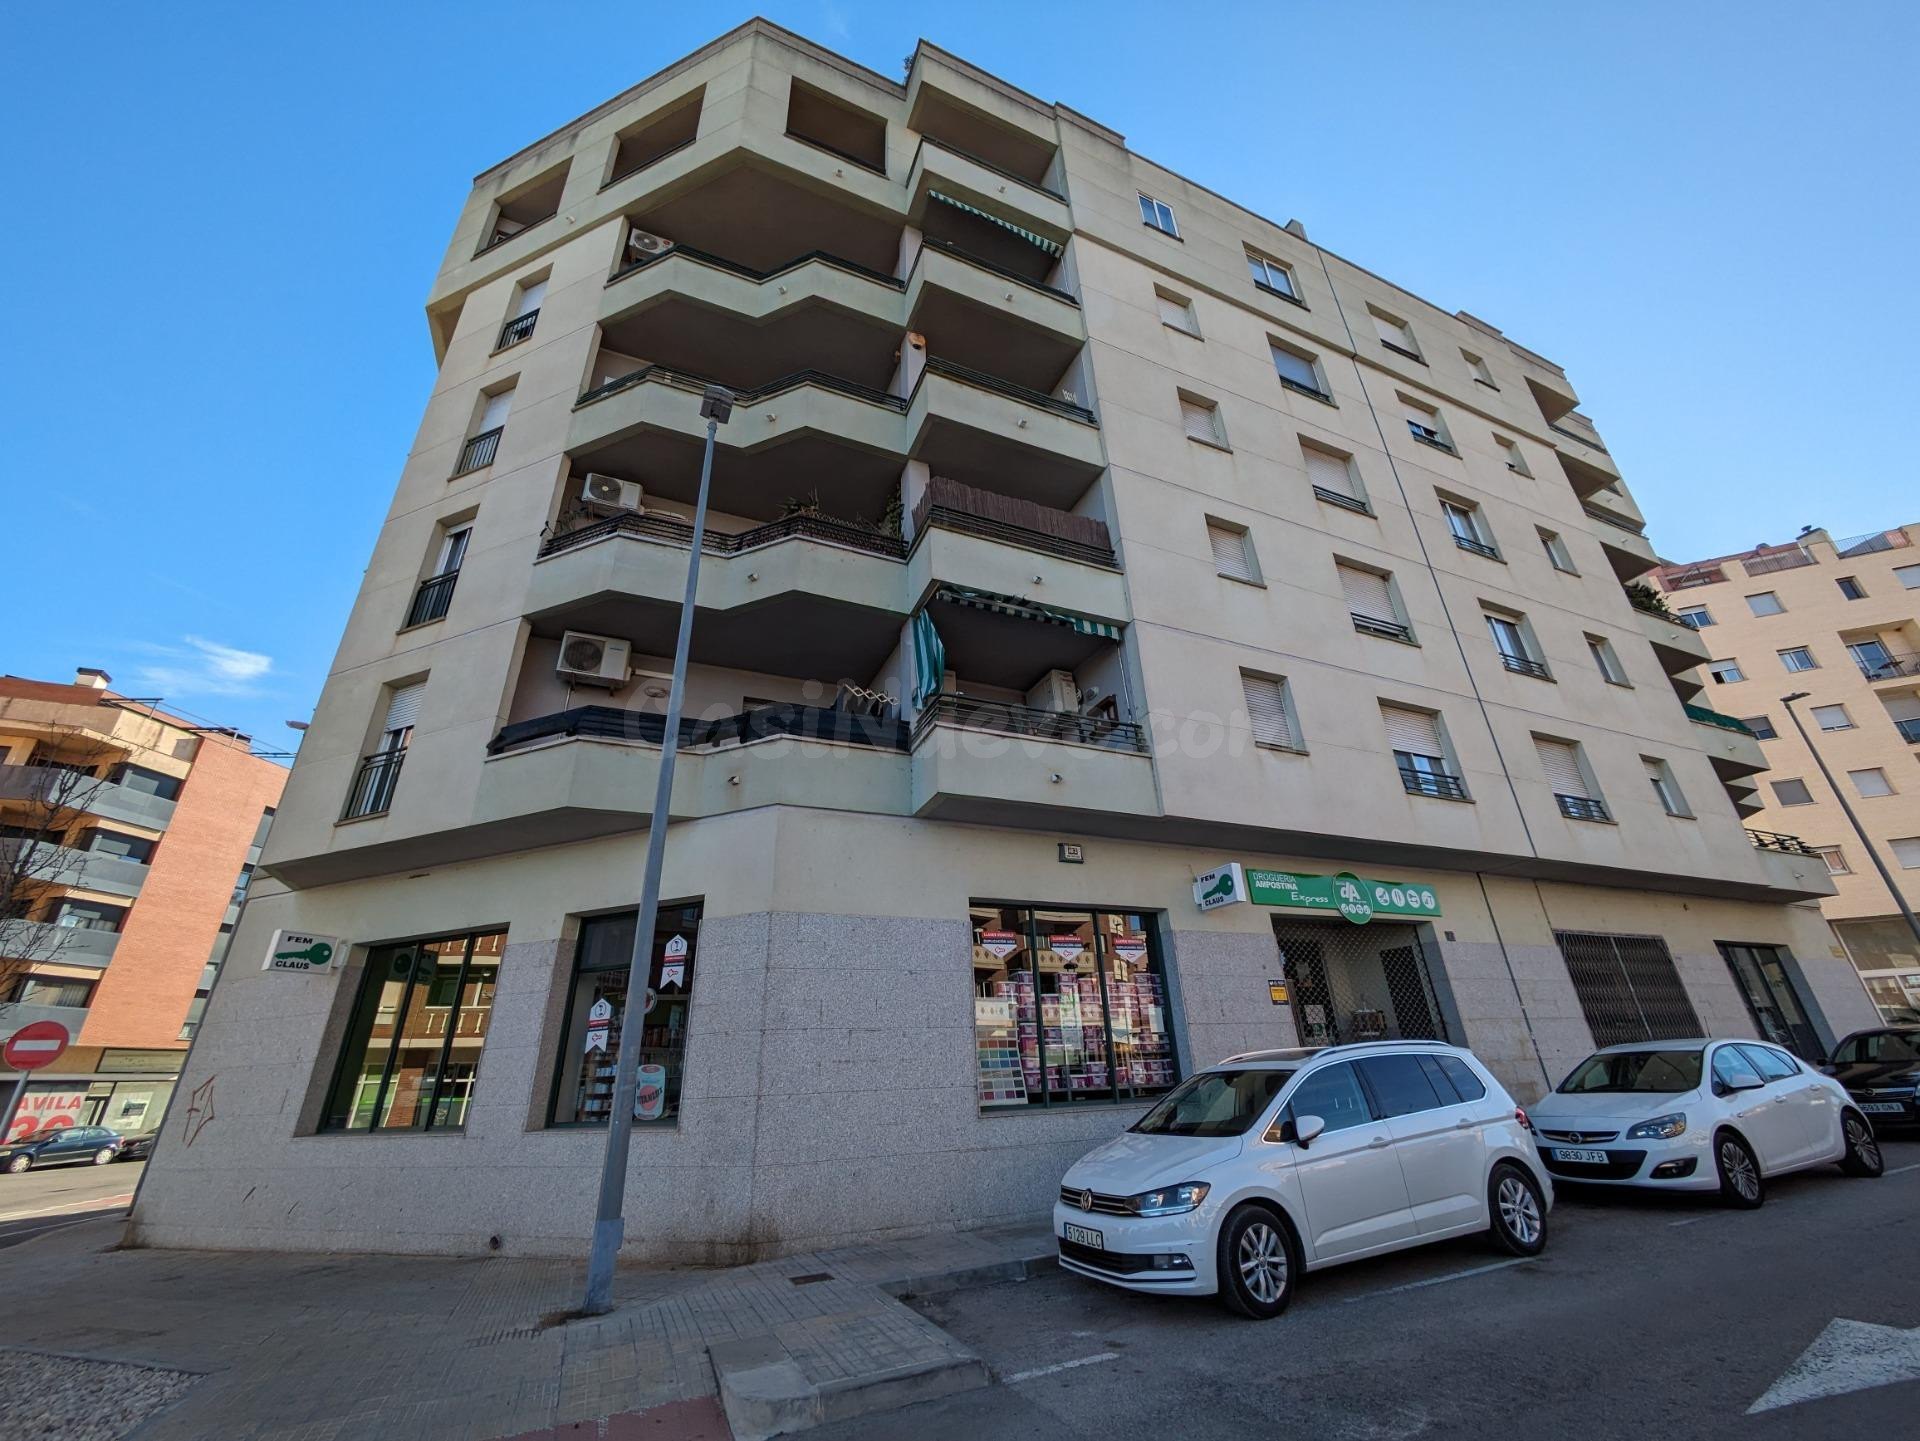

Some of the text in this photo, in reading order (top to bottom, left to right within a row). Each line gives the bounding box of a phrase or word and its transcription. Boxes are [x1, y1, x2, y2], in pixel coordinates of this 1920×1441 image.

[1200, 873, 1216, 883] FEM
[1255, 880, 1298, 891] AMPOSTINA
[1204, 896, 1225, 907] CLAUS
[1291, 891, 1329, 907] Express
[287, 935, 314, 945] FEM
[275, 960, 310, 970] CLAUS
[1559, 1150, 1605, 1162] 9830 JFB
[1067, 1226, 1101, 1247] 5129 LLC
